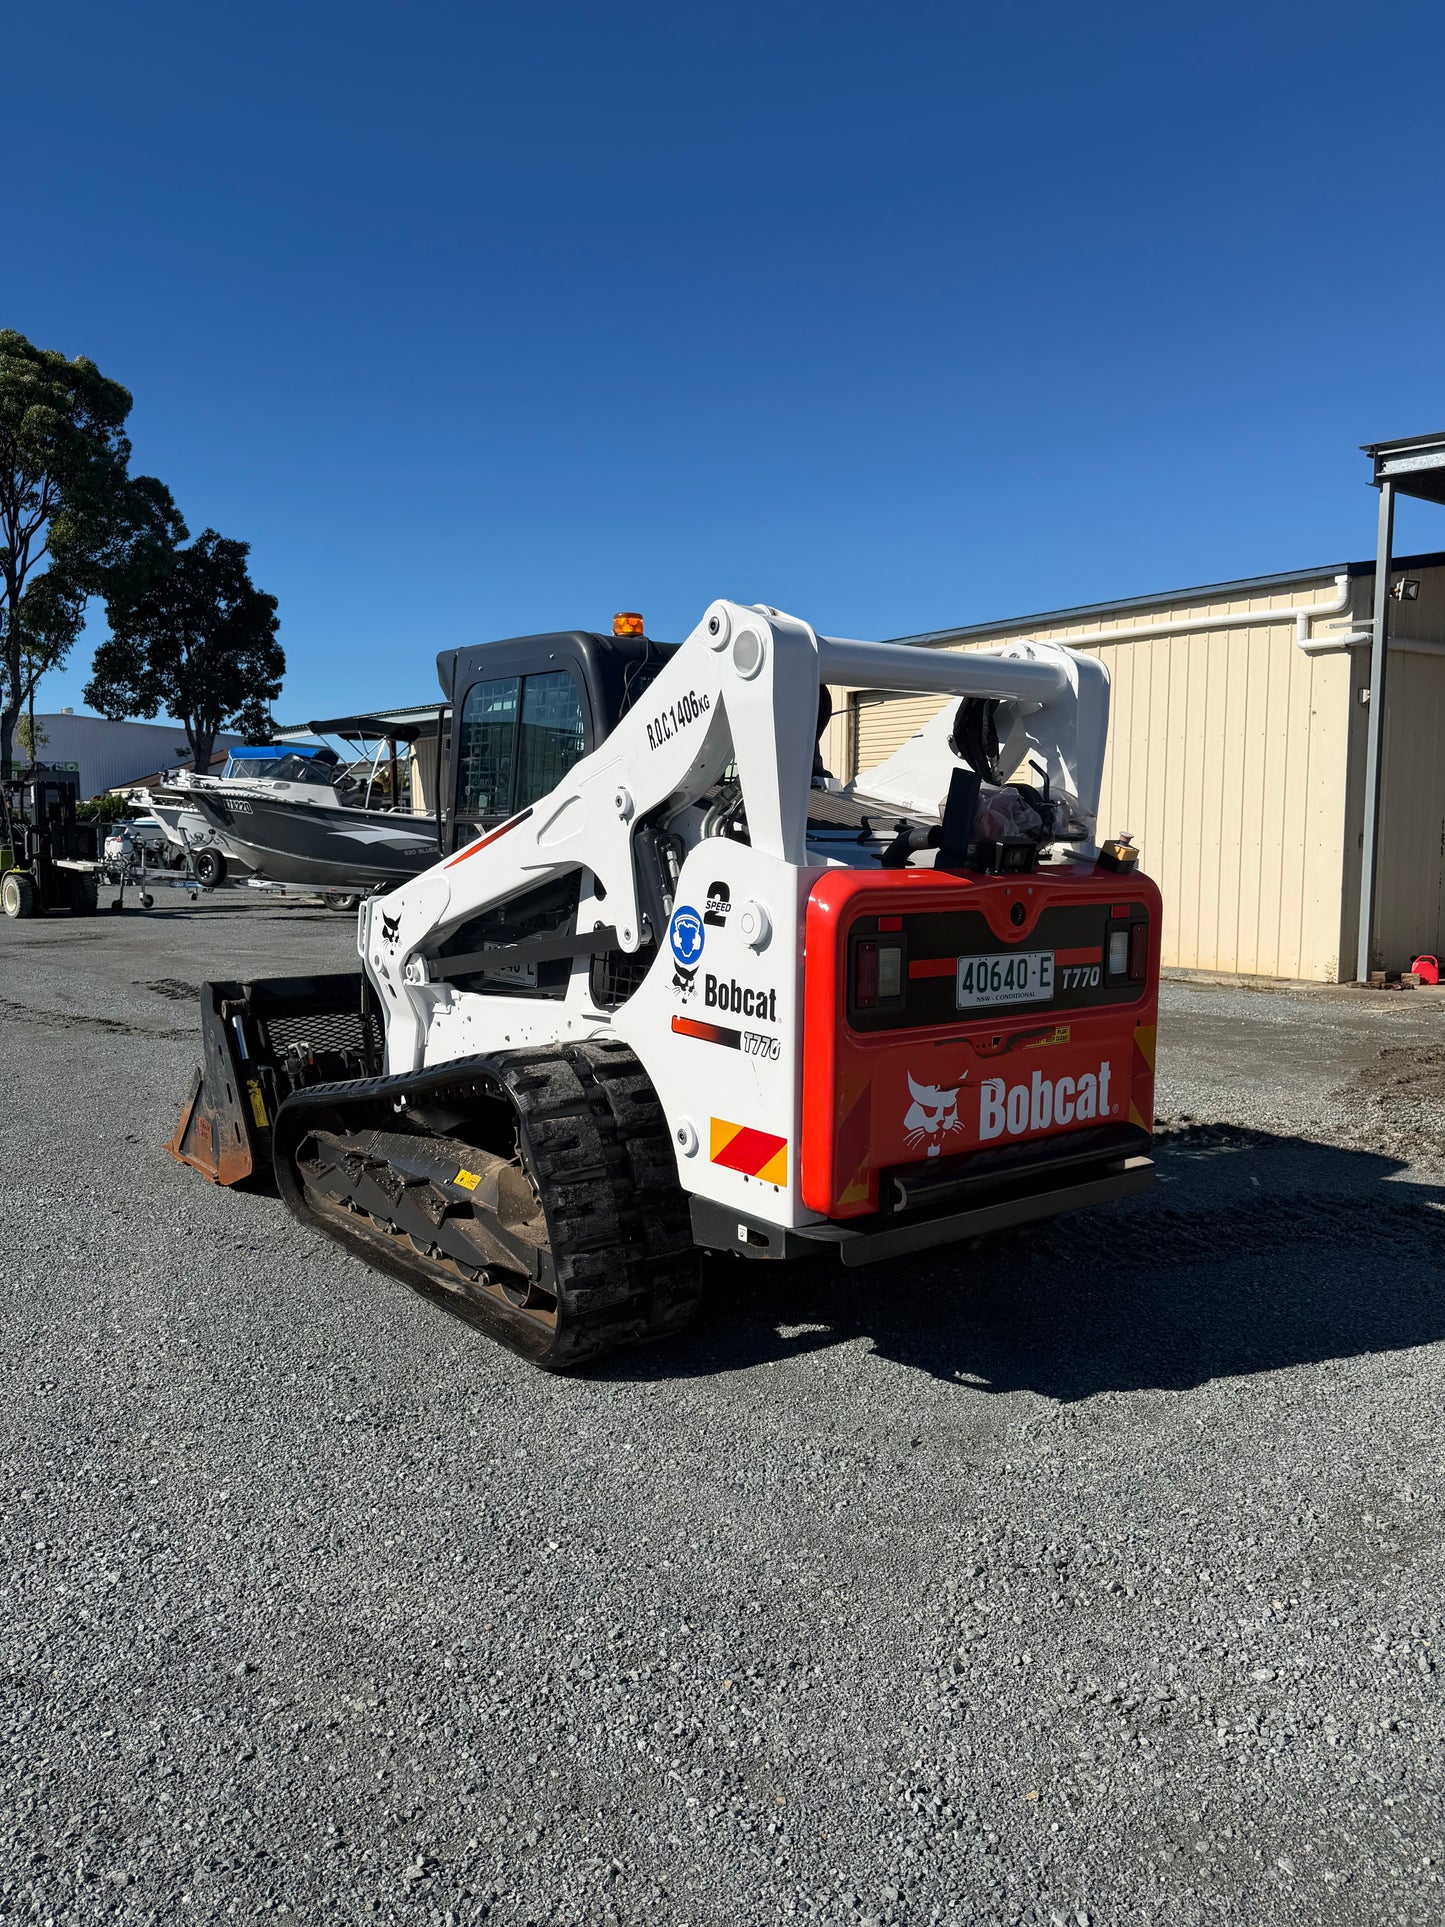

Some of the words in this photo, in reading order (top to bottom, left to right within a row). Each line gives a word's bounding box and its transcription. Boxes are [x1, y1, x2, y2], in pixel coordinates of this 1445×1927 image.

[704, 881, 730, 927] 2
[705, 900, 731, 912] SPEED
[1062, 966, 1100, 989] T770
[704, 973, 777, 1023] Bobcat
[995, 991, 1037, 1001] CONDITIONAL
[744, 1031, 781, 1060] T770
[979, 1061, 1111, 1141] Bobcat
